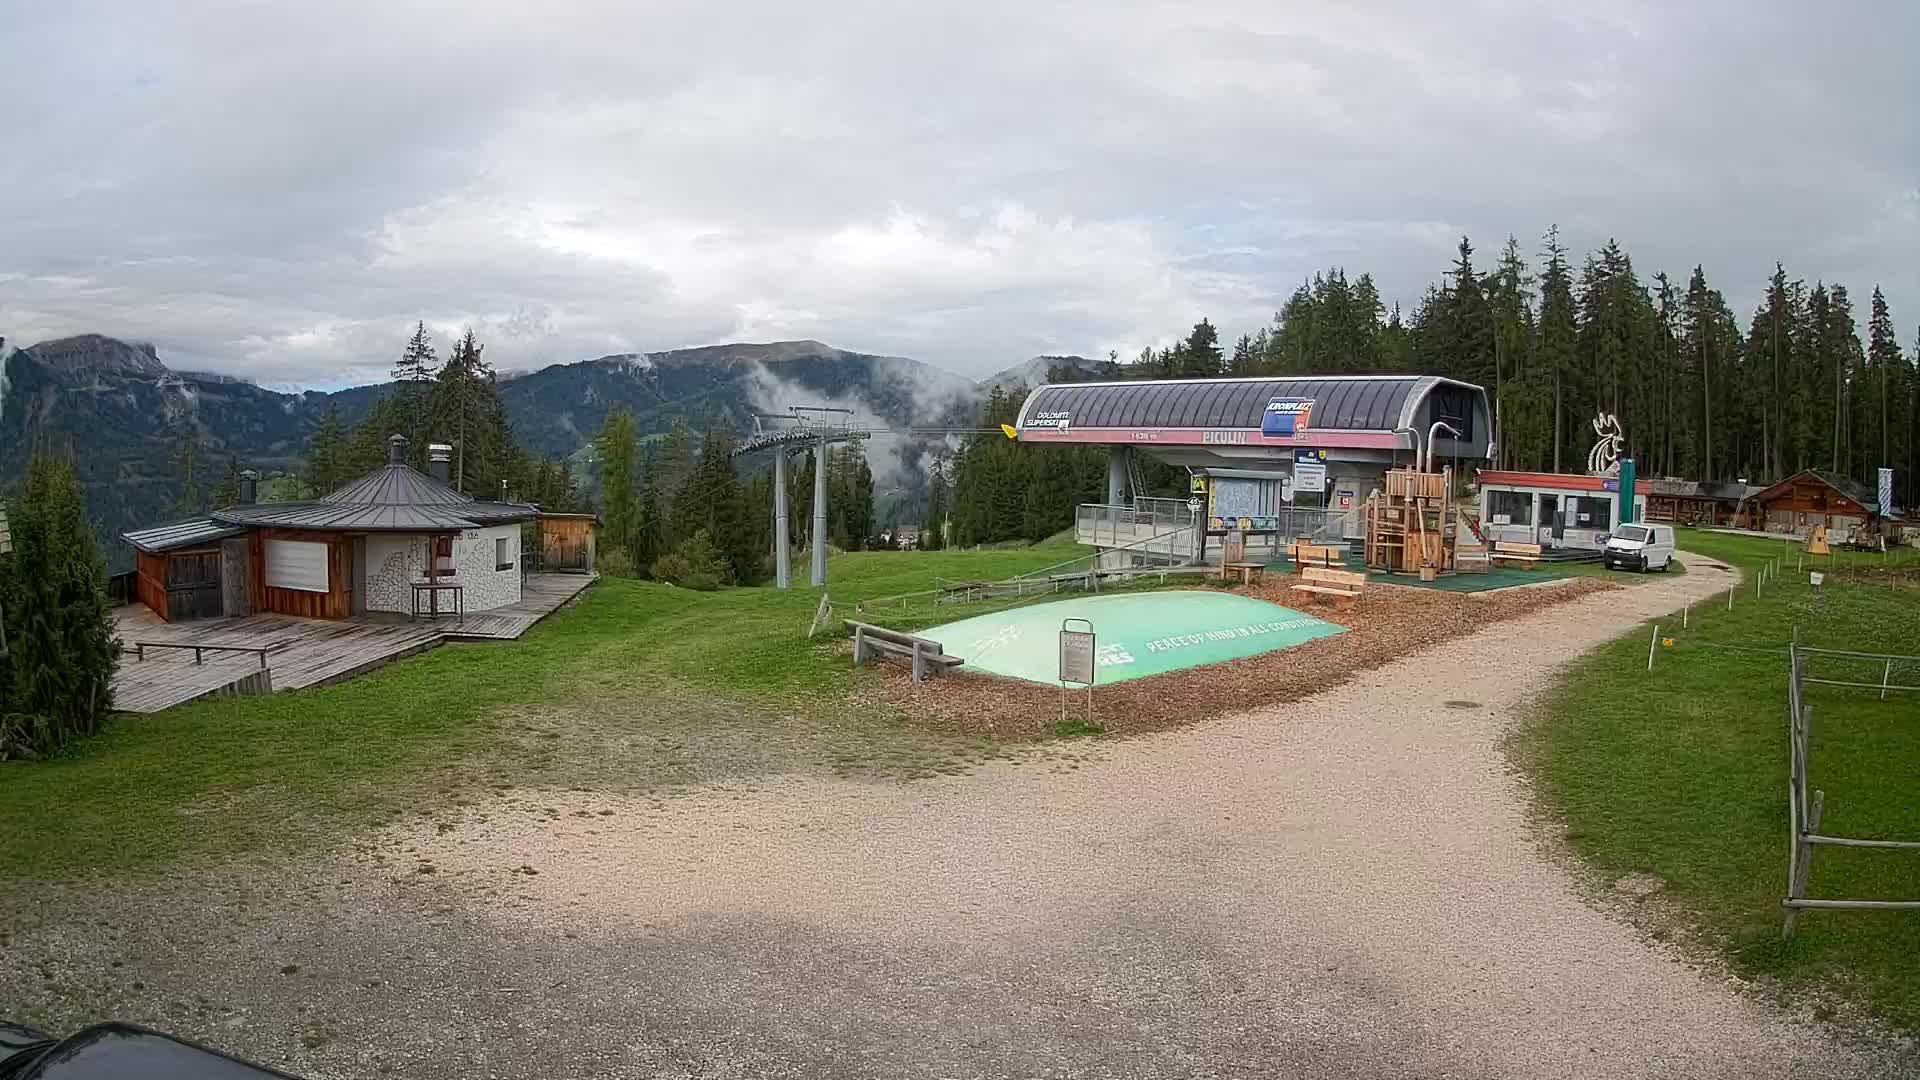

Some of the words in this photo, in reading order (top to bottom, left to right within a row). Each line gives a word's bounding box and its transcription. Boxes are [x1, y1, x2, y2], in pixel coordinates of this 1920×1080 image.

[1037, 411, 1069, 419] DOLOMITI
[1202, 431, 1247, 444] PICULIN
[1146, 635, 1189, 652] PEACE
[1190, 633, 1205, 645] OF
[1207, 629, 1235, 641] MIND
[1234, 627, 1250, 637] IN
[1250, 623, 1269, 635] ALL
